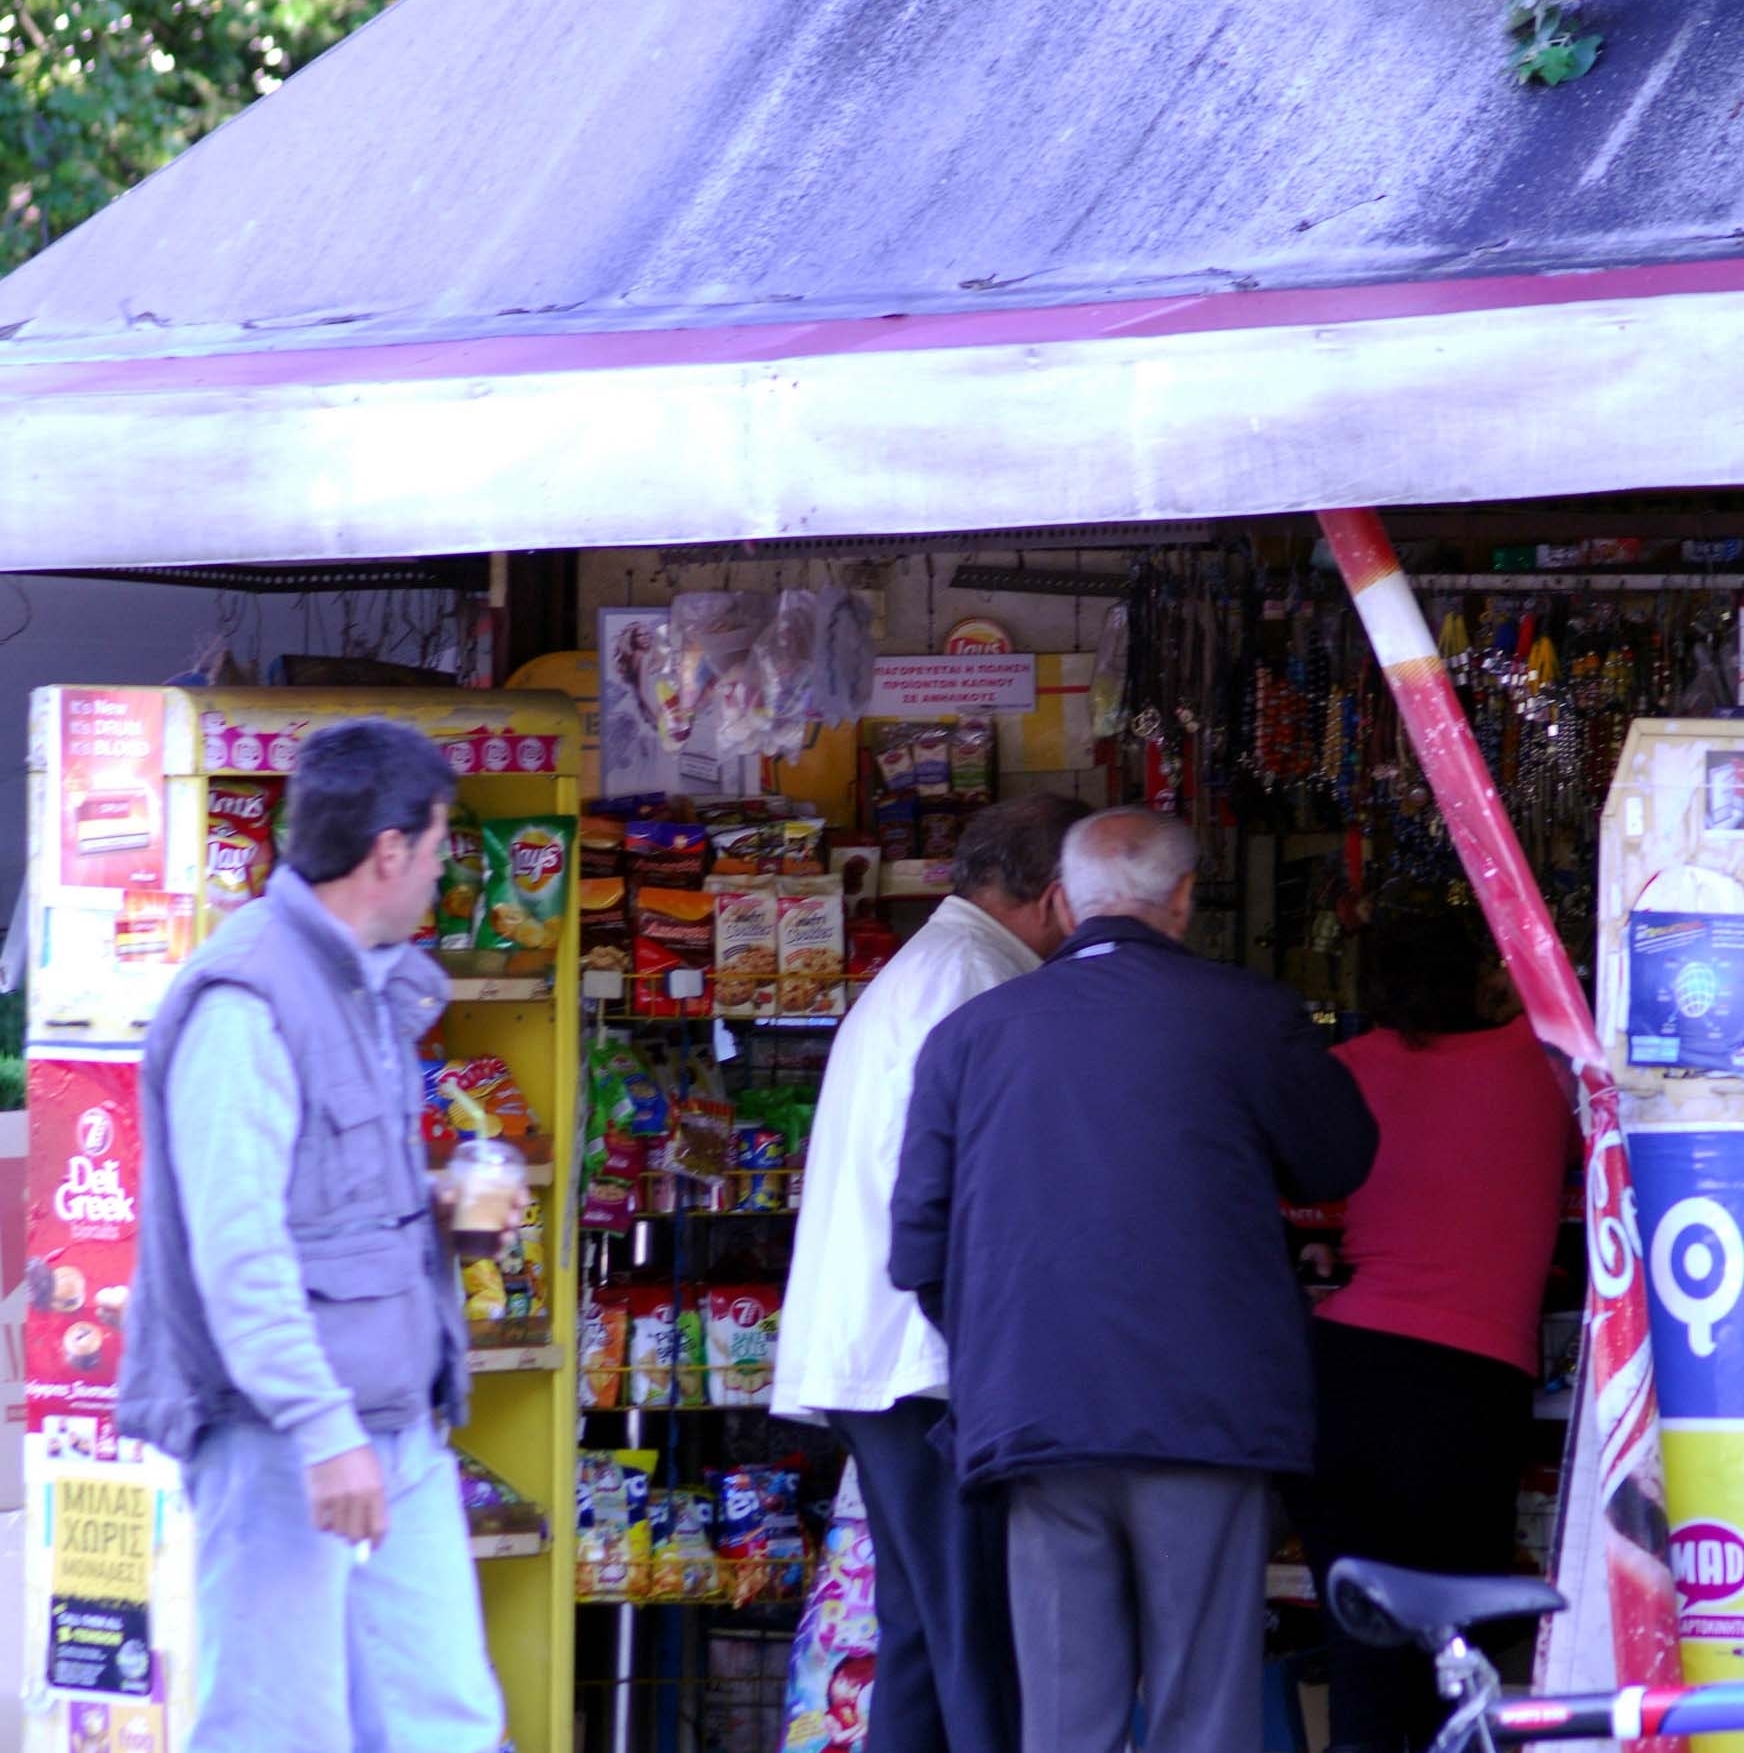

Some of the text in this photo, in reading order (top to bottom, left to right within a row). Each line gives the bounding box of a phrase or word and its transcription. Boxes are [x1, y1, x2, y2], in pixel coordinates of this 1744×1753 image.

[512, 841, 562, 883] Lay's
[68, 1154, 121, 1193] Deli
[54, 1182, 135, 1222] Greek
[63, 1482, 144, 1518] ΜΙΛΑΣ
[63, 1519, 144, 1557] ΧΩΡΙΣ
[1673, 1540, 1744, 1586] MAD
